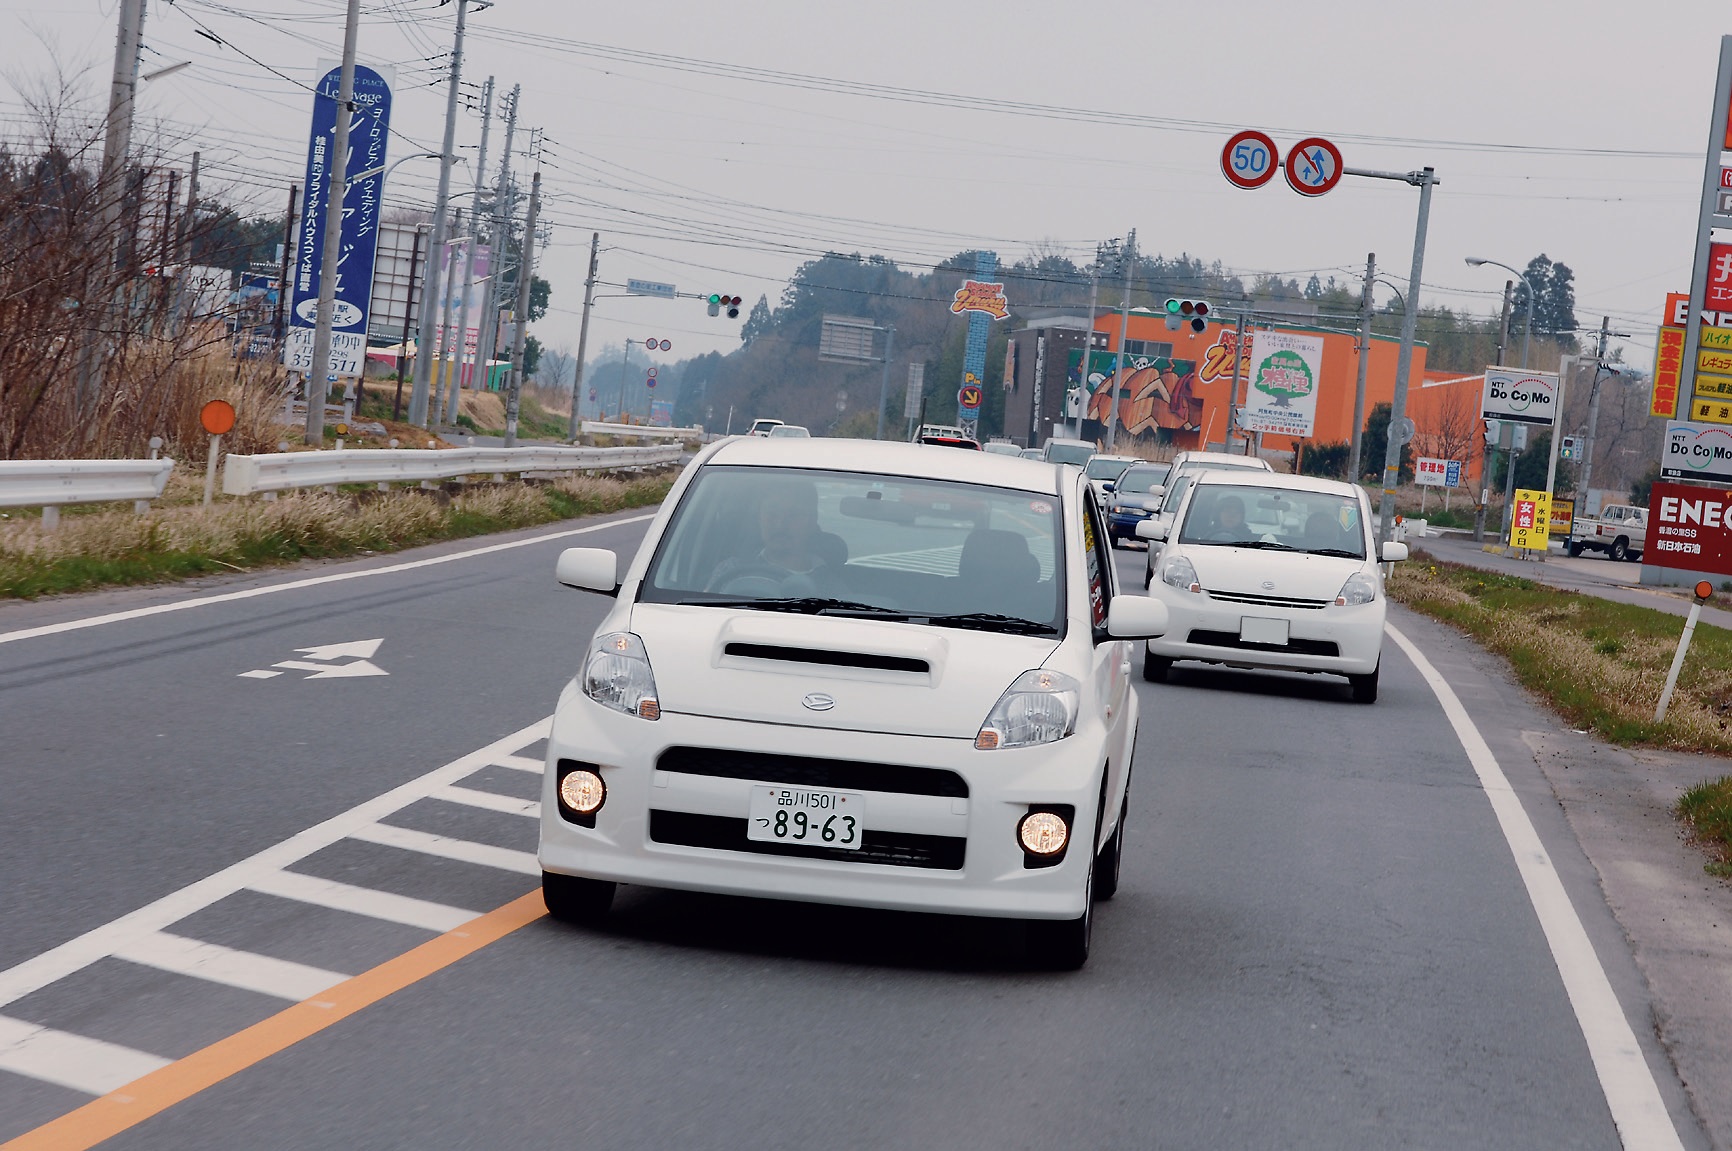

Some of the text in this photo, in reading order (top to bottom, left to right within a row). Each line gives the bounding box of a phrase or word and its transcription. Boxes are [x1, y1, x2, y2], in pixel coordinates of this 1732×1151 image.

[1234, 145, 1266, 172] 50
[1653, 330, 1683, 415] 現金会員価格
[1491, 381, 1505, 389] NTT
[1420, 461, 1445, 474] 管理地
[1656, 539, 1701, 555] 新日本石油
[773, 809, 856, 844] 89-63
